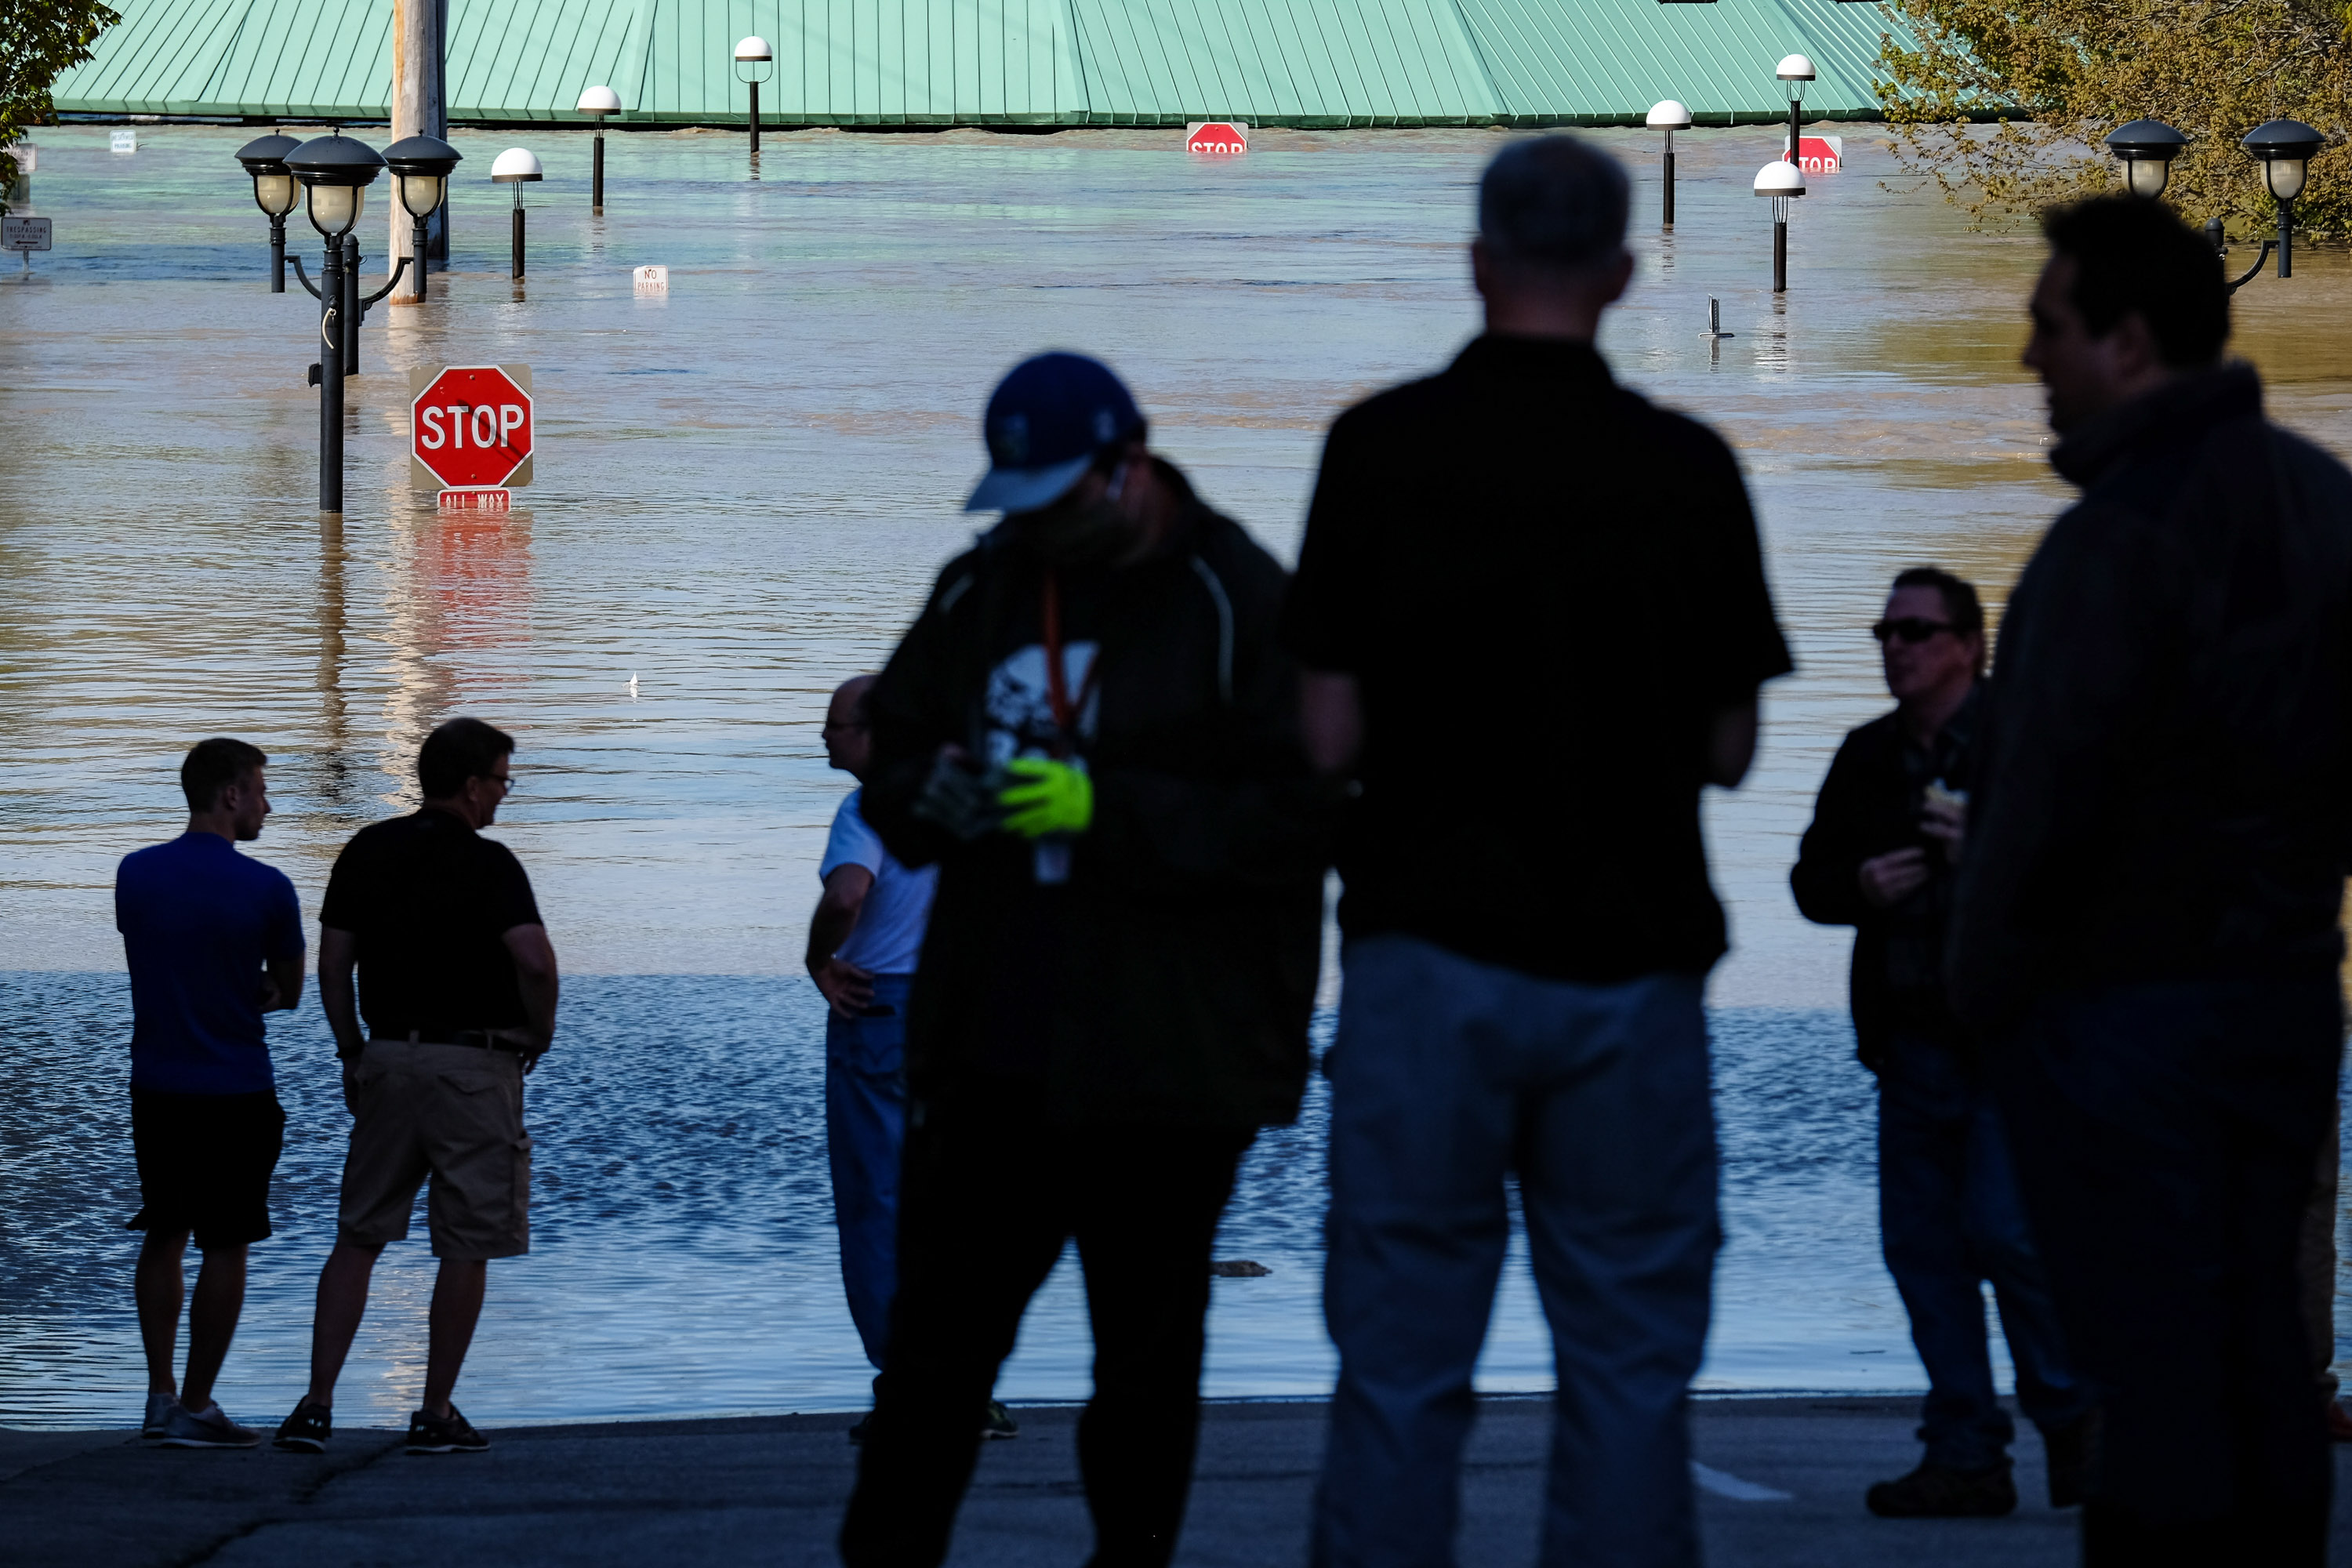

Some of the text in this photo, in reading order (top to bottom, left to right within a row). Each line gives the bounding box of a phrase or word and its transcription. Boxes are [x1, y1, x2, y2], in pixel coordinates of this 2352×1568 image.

[1788, 157, 1836, 170] TOP
[644, 270, 657, 279] NO
[637, 281, 665, 292] PARKING
[421, 404, 524, 450] STOP
